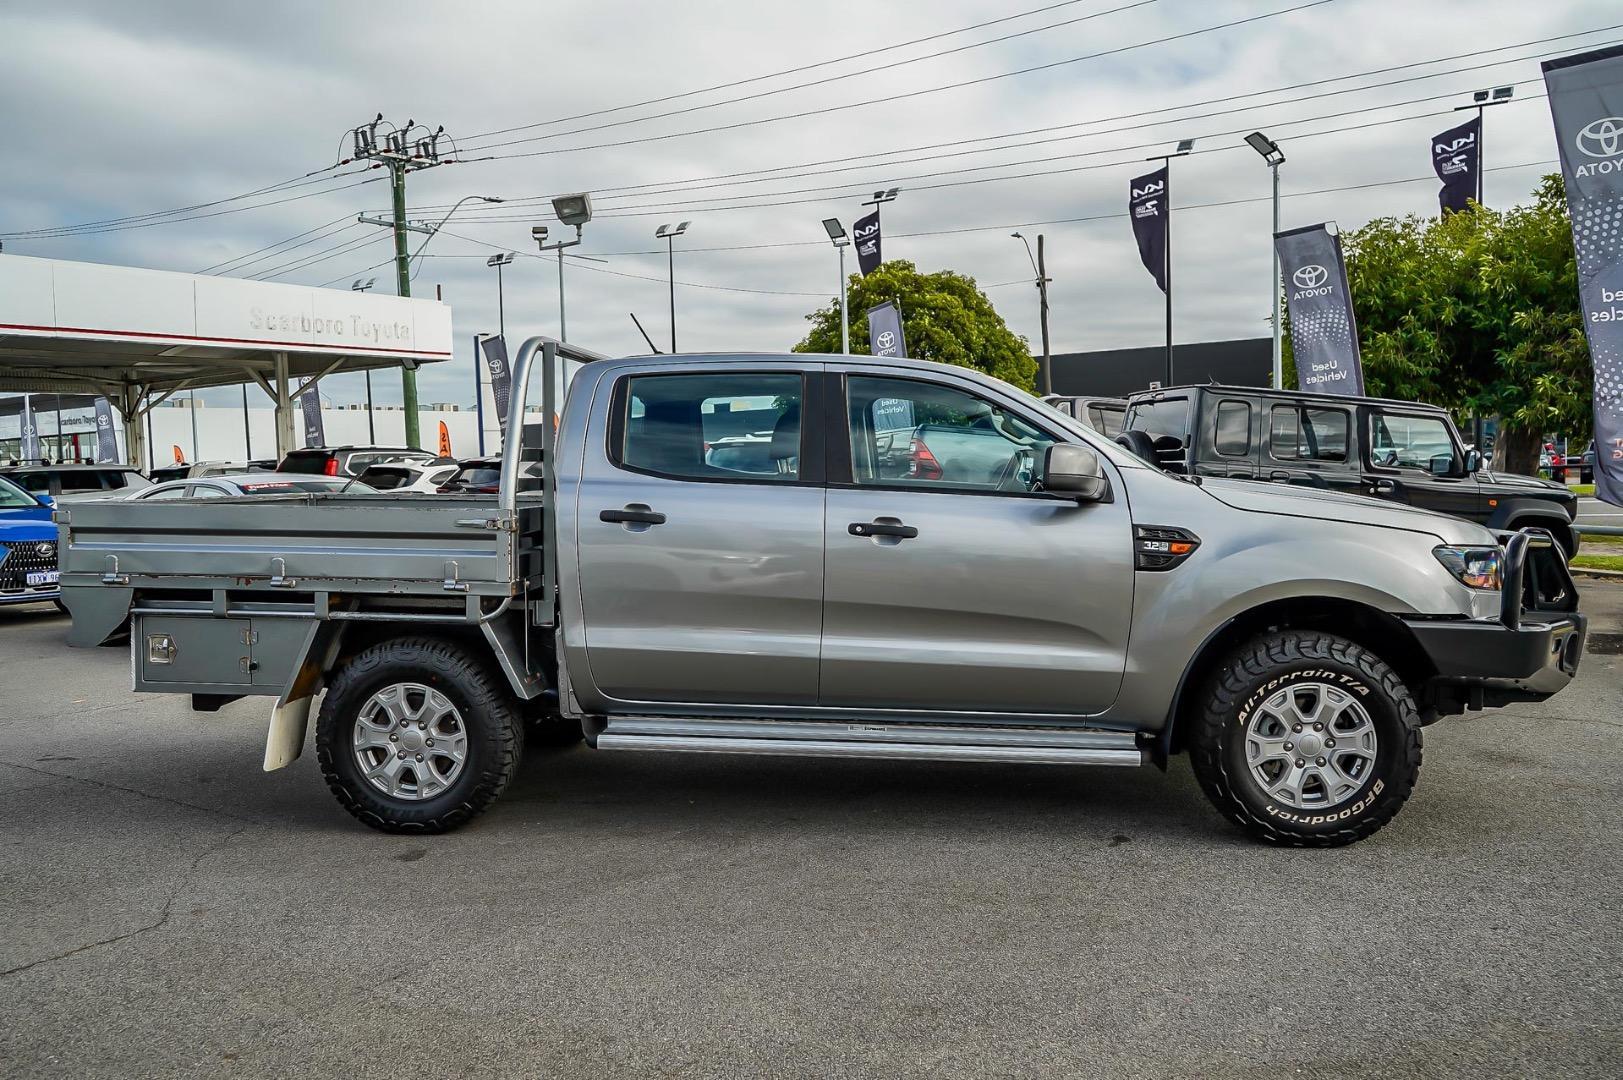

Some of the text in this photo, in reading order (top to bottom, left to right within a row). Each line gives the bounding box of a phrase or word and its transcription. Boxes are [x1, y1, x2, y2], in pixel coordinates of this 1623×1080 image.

[249, 306, 410, 343] Scarboro Toyota
[1238, 668, 1371, 726] All-Terrain T/A
[1265, 778, 1385, 825] BFGoodrich
